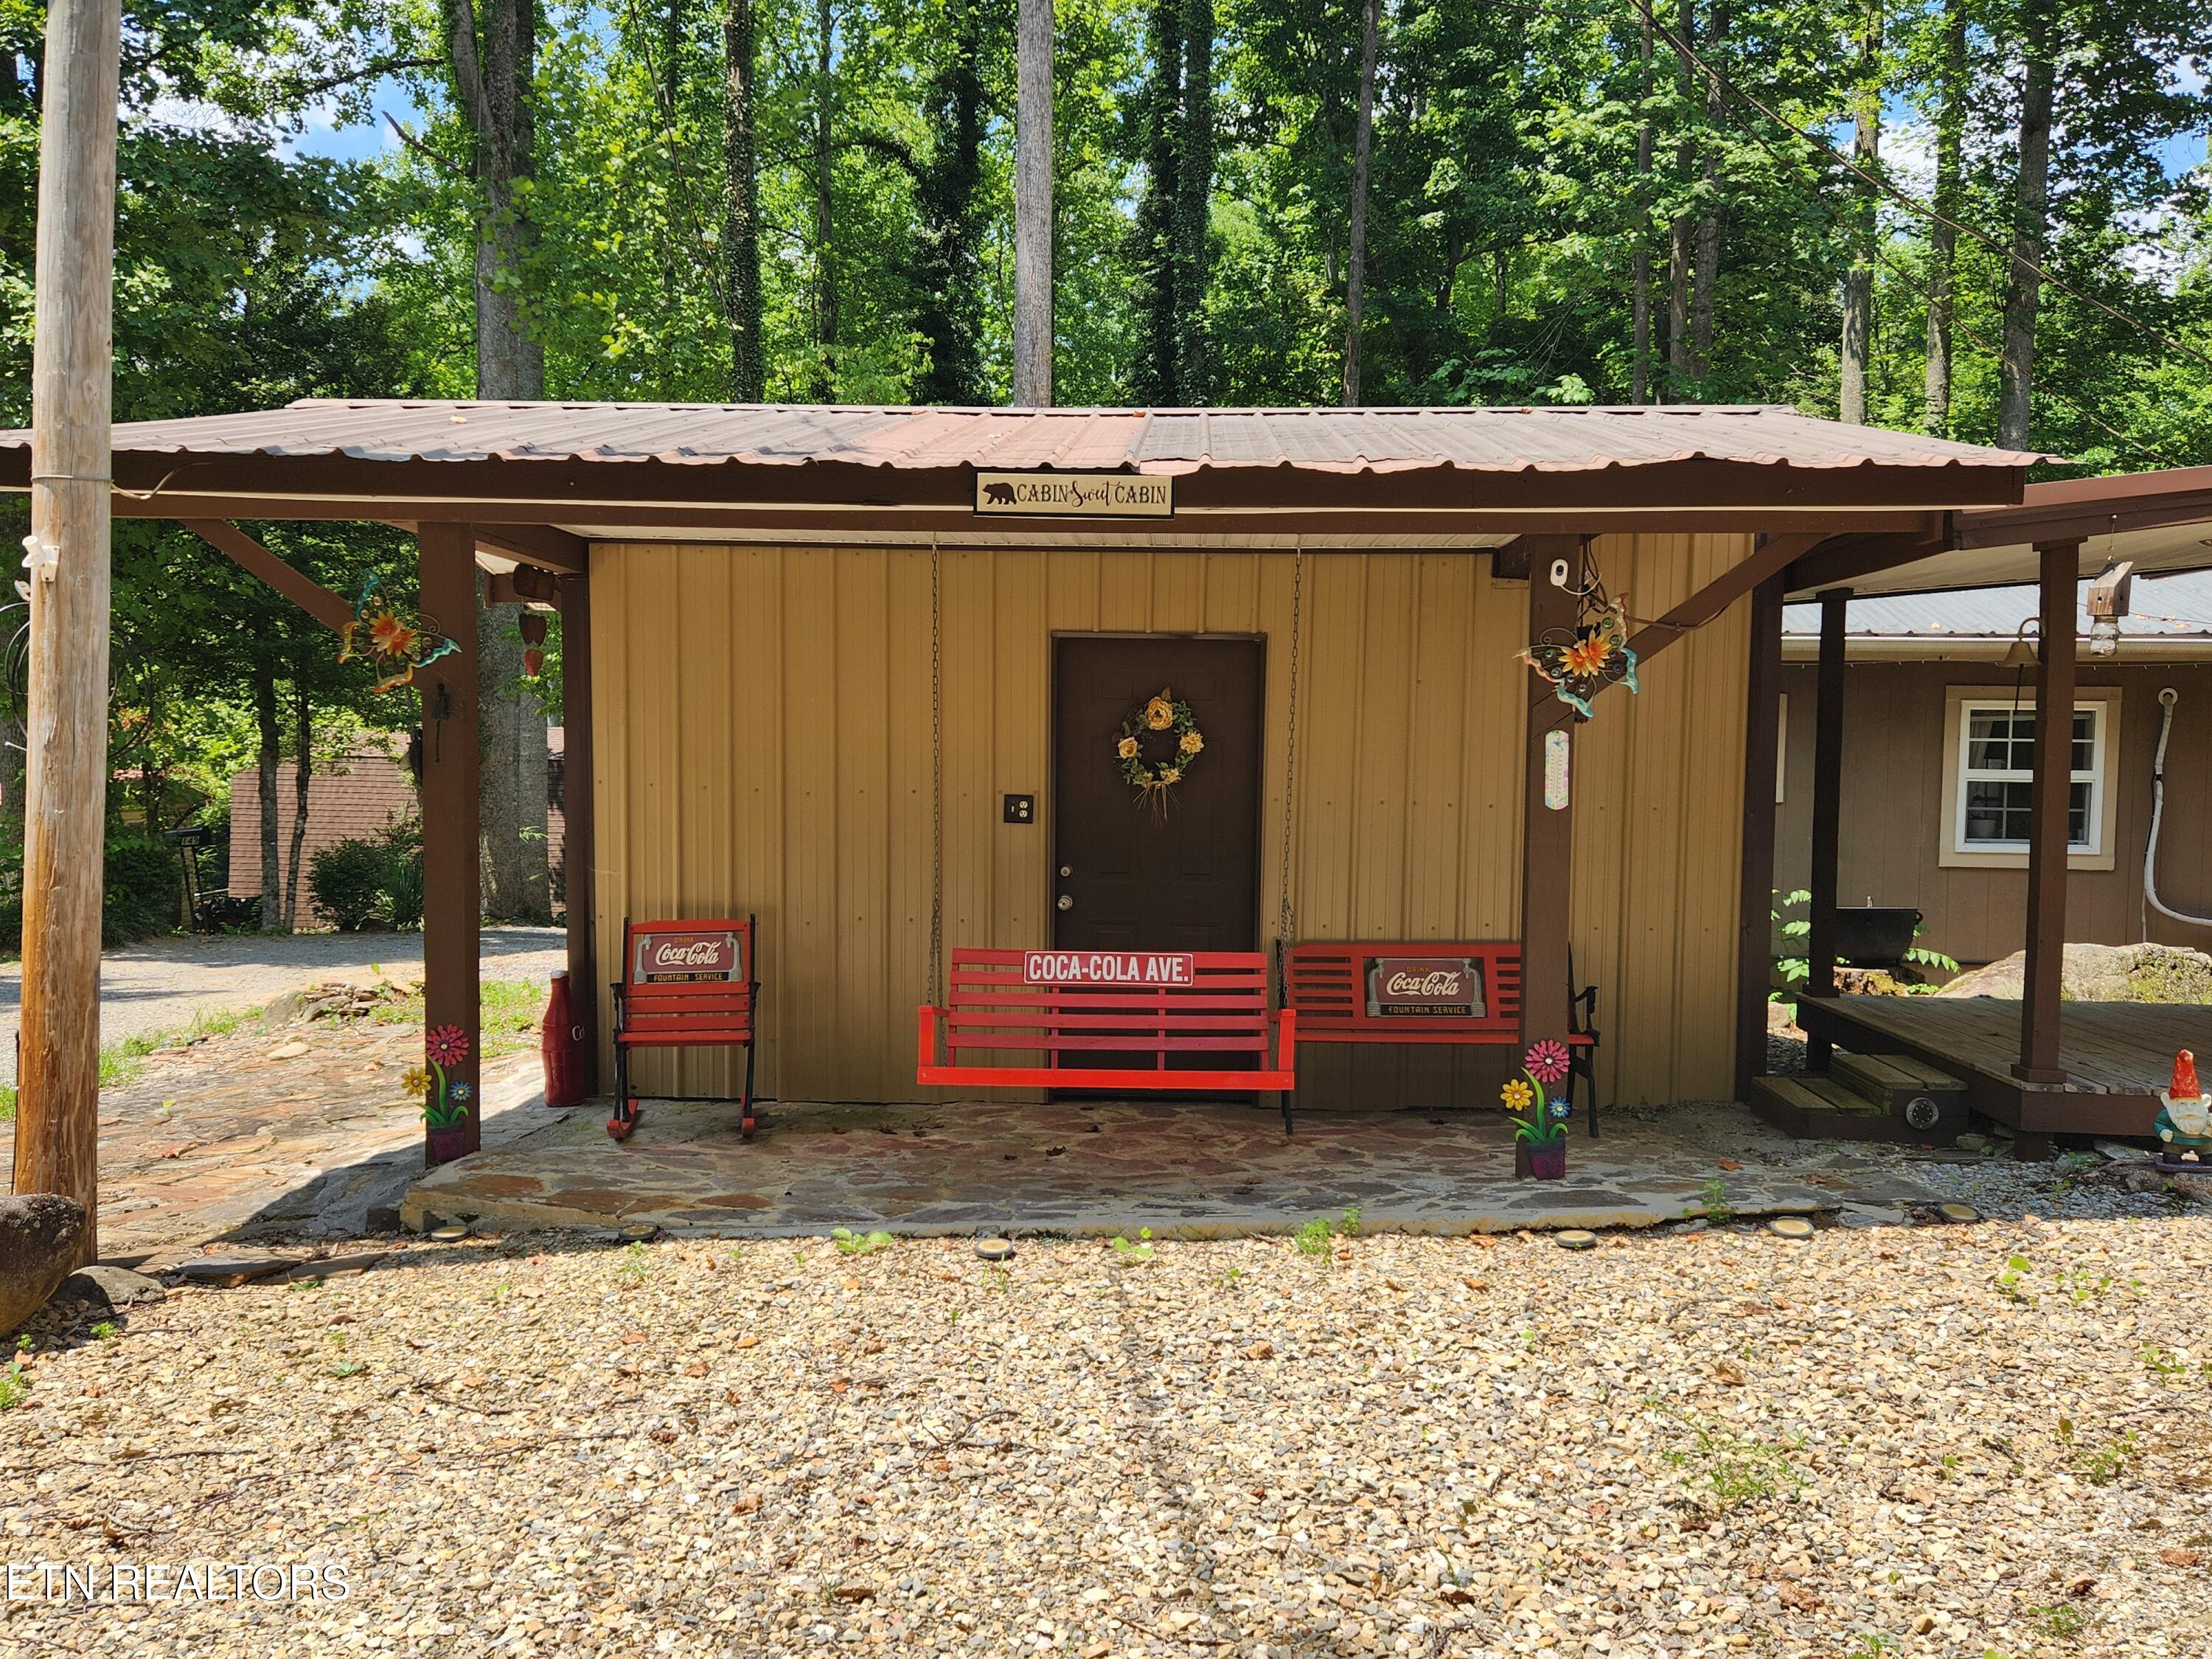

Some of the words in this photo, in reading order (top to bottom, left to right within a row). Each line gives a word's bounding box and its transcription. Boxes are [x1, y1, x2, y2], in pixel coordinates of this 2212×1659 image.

[1017, 484, 1068, 502] CABIN
[1068, 481, 1121, 507] Sweet
[1115, 486, 1166, 504] CABIN
[655, 942, 722, 966] Coca-Cola
[1029, 955, 1140, 981] COCA-COLA
[1145, 957, 1189, 981] AVE.
[1386, 971, 1461, 995] Coca-Cola
